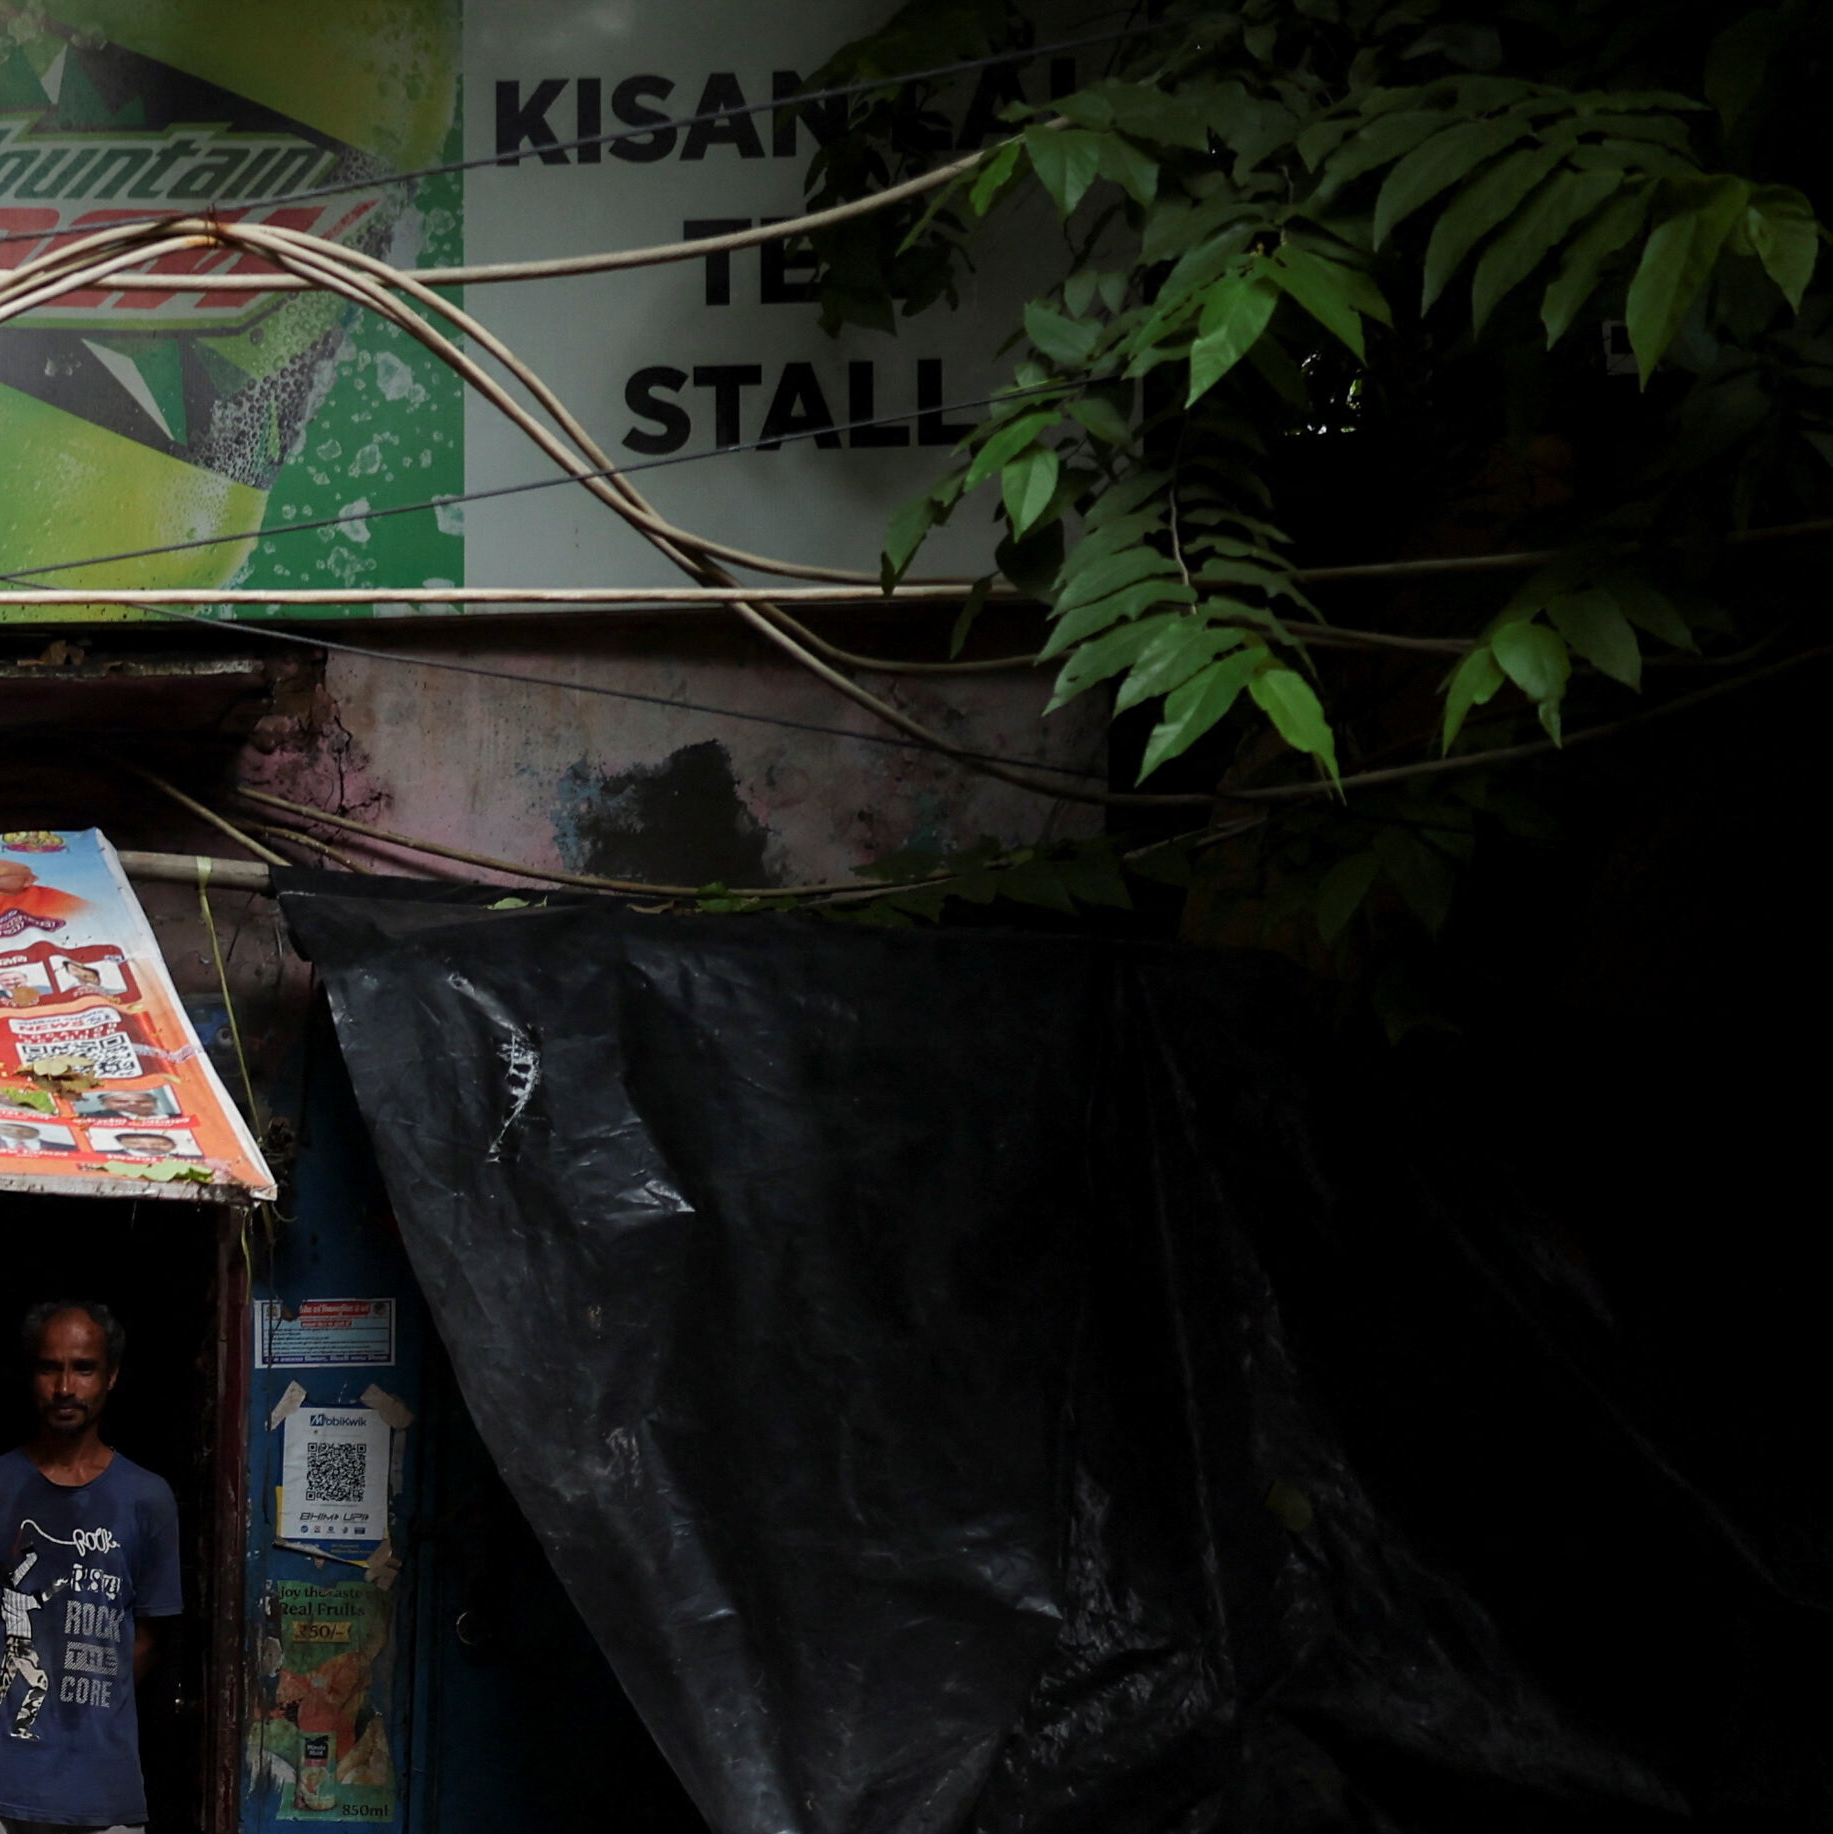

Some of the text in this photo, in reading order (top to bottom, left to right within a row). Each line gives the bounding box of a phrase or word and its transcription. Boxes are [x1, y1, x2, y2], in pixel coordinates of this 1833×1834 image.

[494, 70, 847, 167] KISAN
[622, 358, 979, 455] STALL
[18, 1020, 86, 1033] NEWS
[310, 1413, 367, 1427] MobiKwik
[279, 1602, 366, 1616] Real Fruits
[64, 1600, 125, 1643] ROCK
[69, 1648, 117, 1669] THE
[60, 1675, 113, 1708] CORE
[342, 1804, 389, 1817] 850ml
